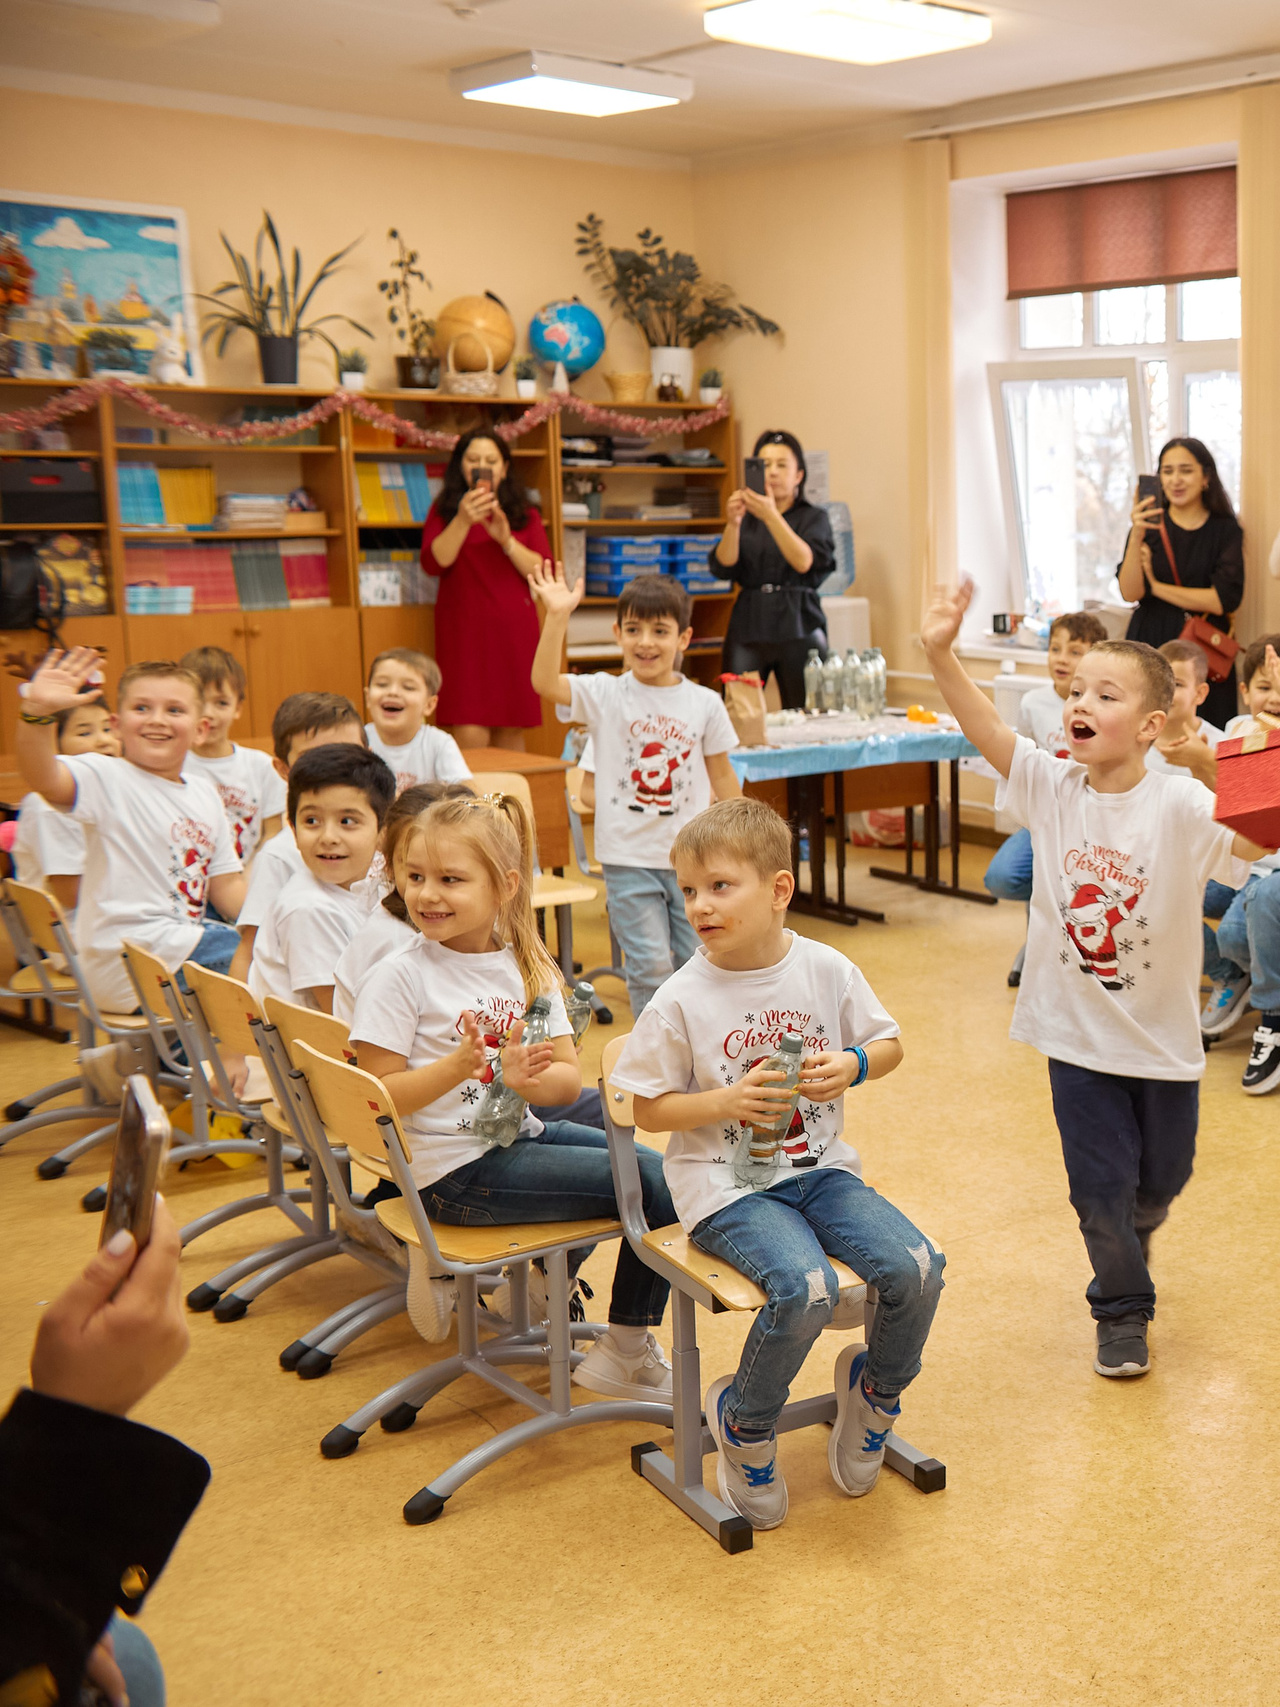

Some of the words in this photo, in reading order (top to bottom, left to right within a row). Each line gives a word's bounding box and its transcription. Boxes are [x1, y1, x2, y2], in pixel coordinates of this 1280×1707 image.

[1090, 845, 1132, 868] Merry
[1064, 849, 1149, 895] Christmas
[760, 1009, 811, 1033] Merry
